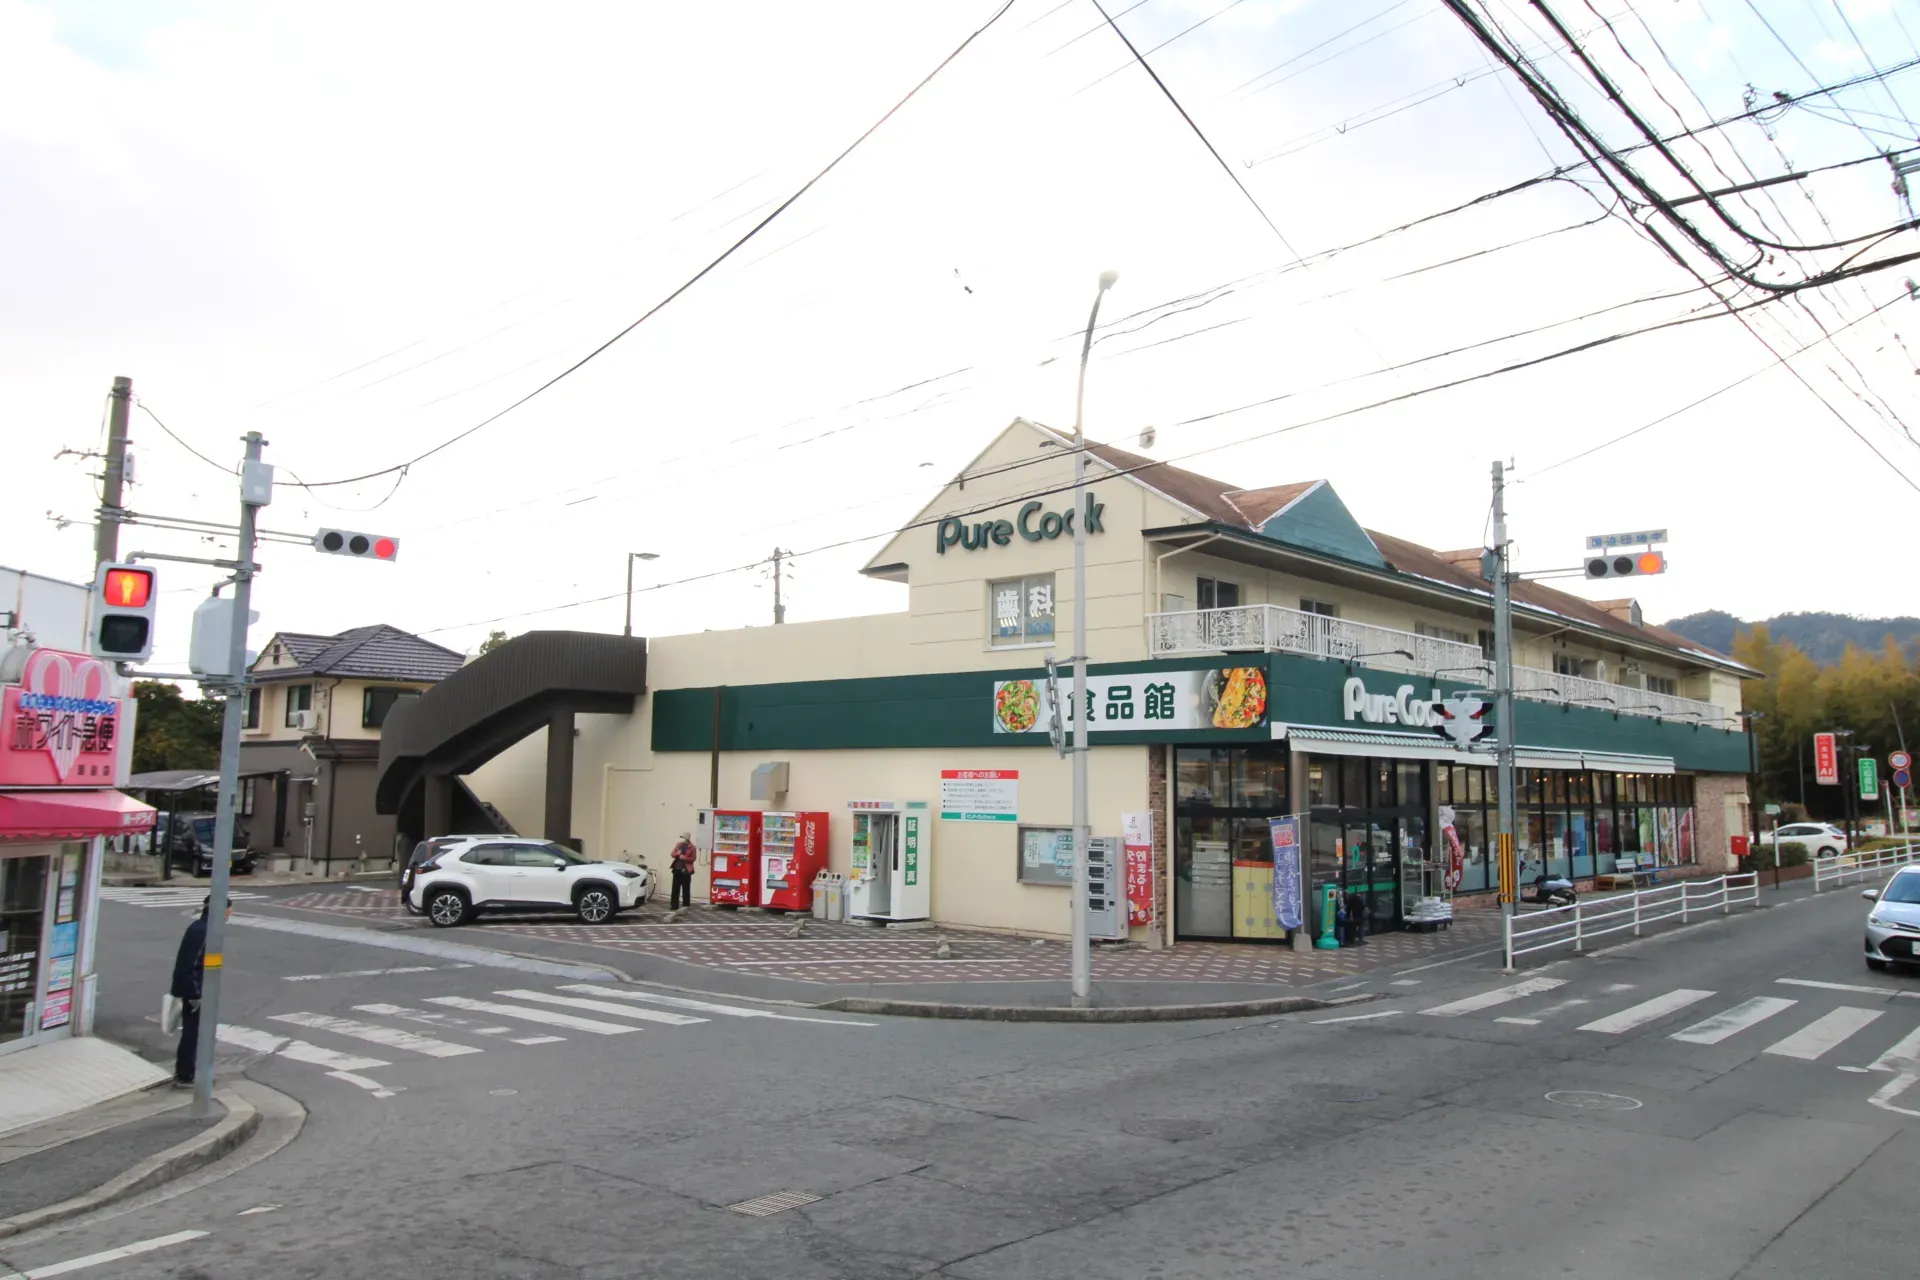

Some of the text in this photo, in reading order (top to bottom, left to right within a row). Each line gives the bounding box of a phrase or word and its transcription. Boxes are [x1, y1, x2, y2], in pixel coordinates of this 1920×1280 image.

[936, 491, 1105, 555] Pure Cook
[997, 584, 1053, 619] 歯科
[12, 711, 116, 752] ホワイト急便
[906, 819, 917, 883] 証明写真
